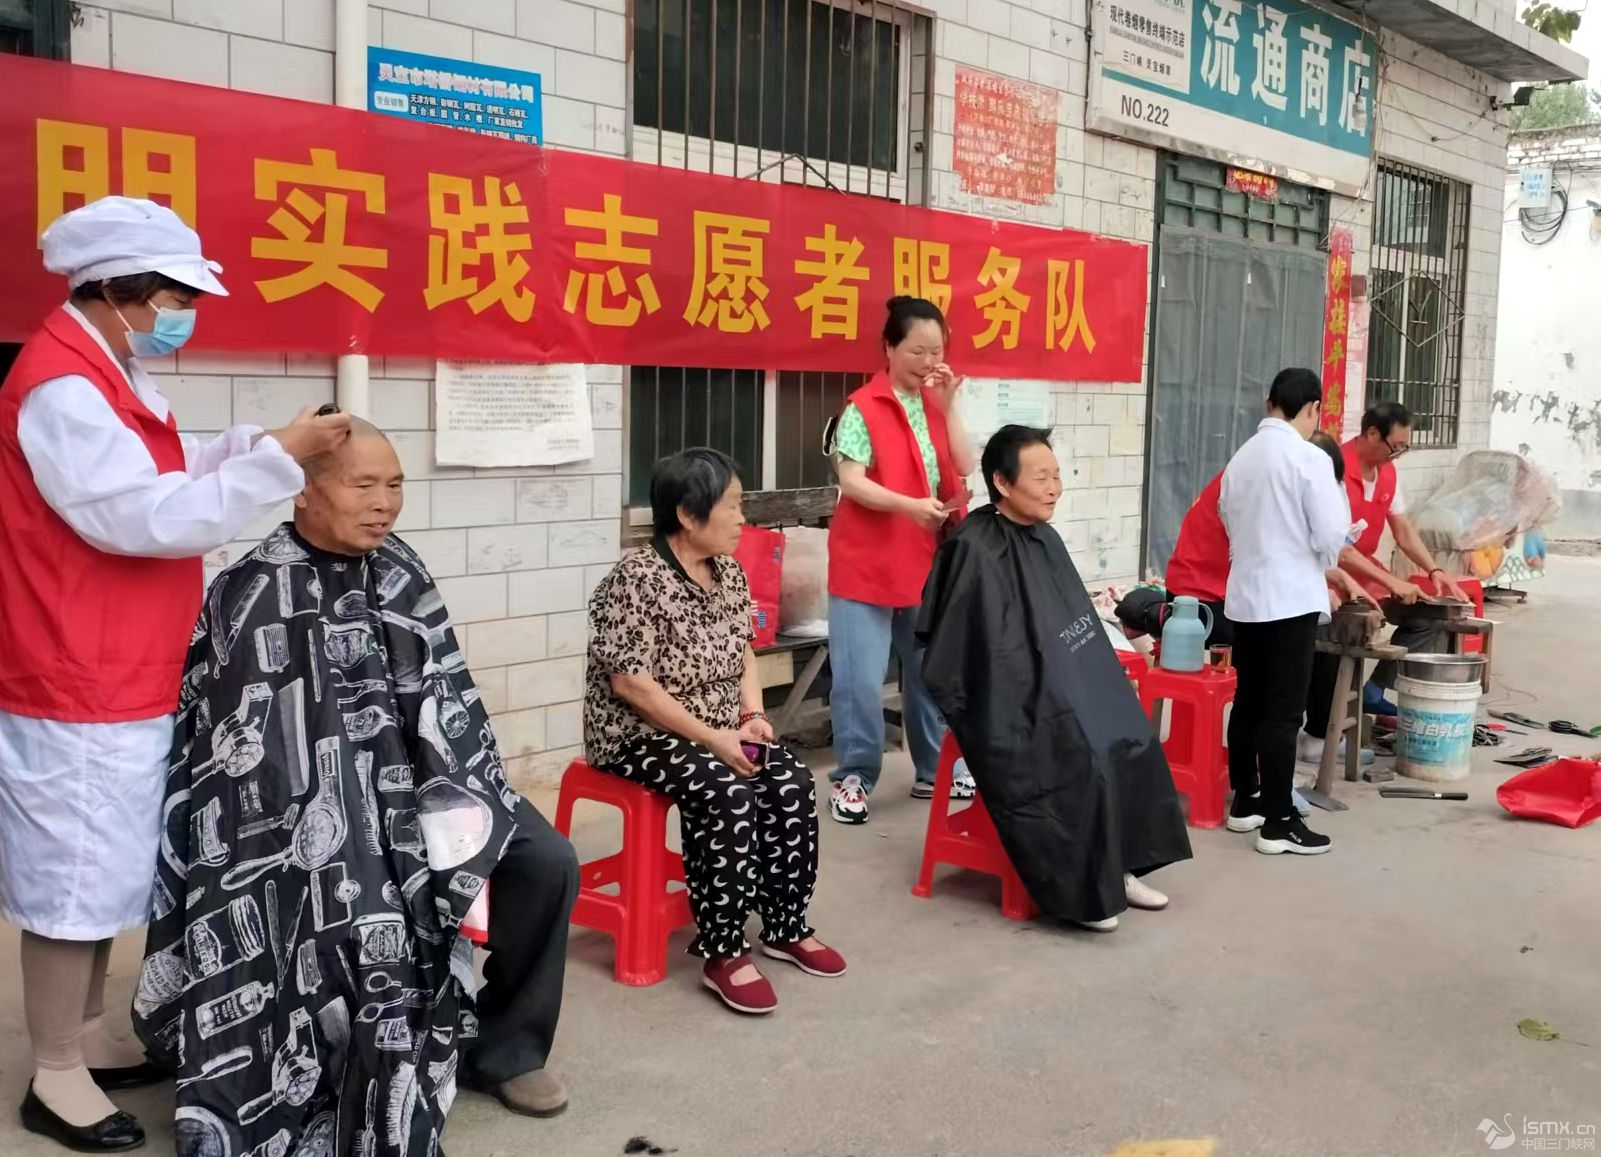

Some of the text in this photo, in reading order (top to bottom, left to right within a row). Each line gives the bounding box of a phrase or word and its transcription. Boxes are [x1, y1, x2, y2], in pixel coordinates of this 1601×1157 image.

[1110, 5, 1185, 48] 现代卷烟零售终端示范店
[1200, 0, 1371, 137] 流通商店
[1121, 94, 1169, 127] NO.222
